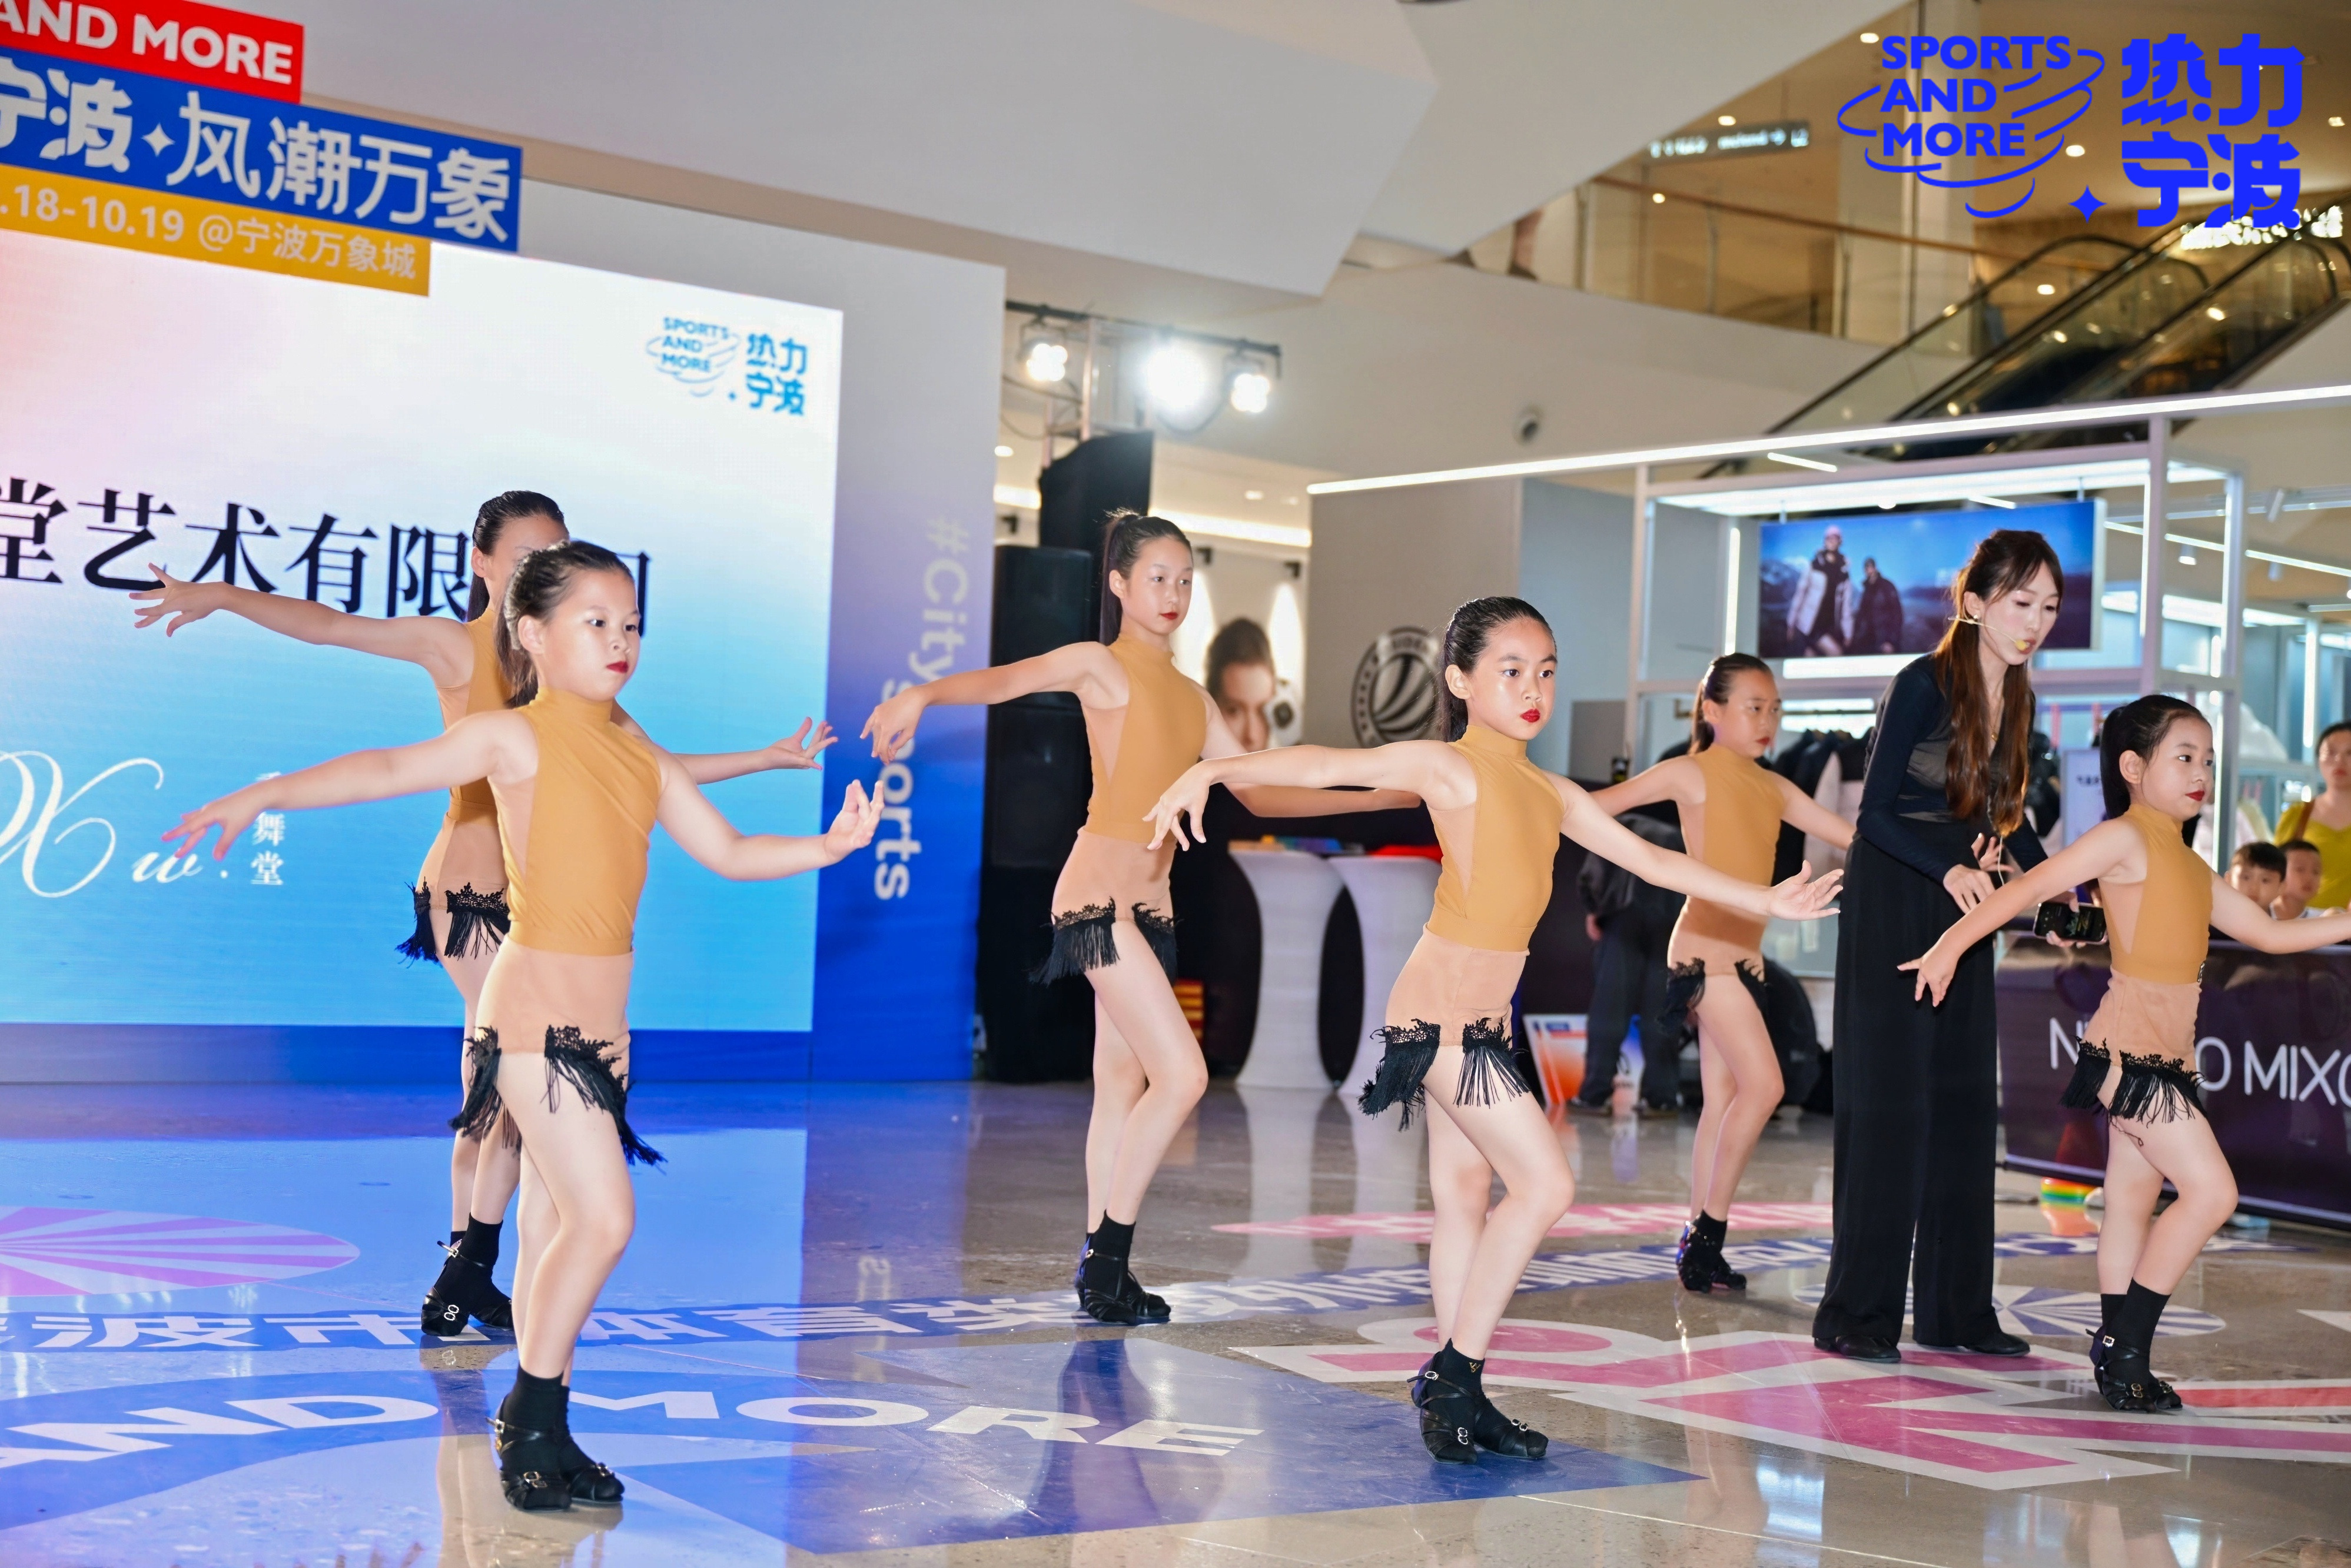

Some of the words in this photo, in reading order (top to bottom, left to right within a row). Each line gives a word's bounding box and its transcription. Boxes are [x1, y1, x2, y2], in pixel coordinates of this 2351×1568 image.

[132, 14, 294, 85] MORE
[167, 91, 510, 242] 风潮万象
[198, 215, 416, 279] @宁波万象城
[662, 335, 703, 353] AND
[663, 317, 729, 340] SPORTS
[662, 353, 711, 373] MORE
[746, 333, 808, 375] 热力
[746, 372, 805, 416] 宁波
[0, 476, 652, 637] 堂艺术有限
